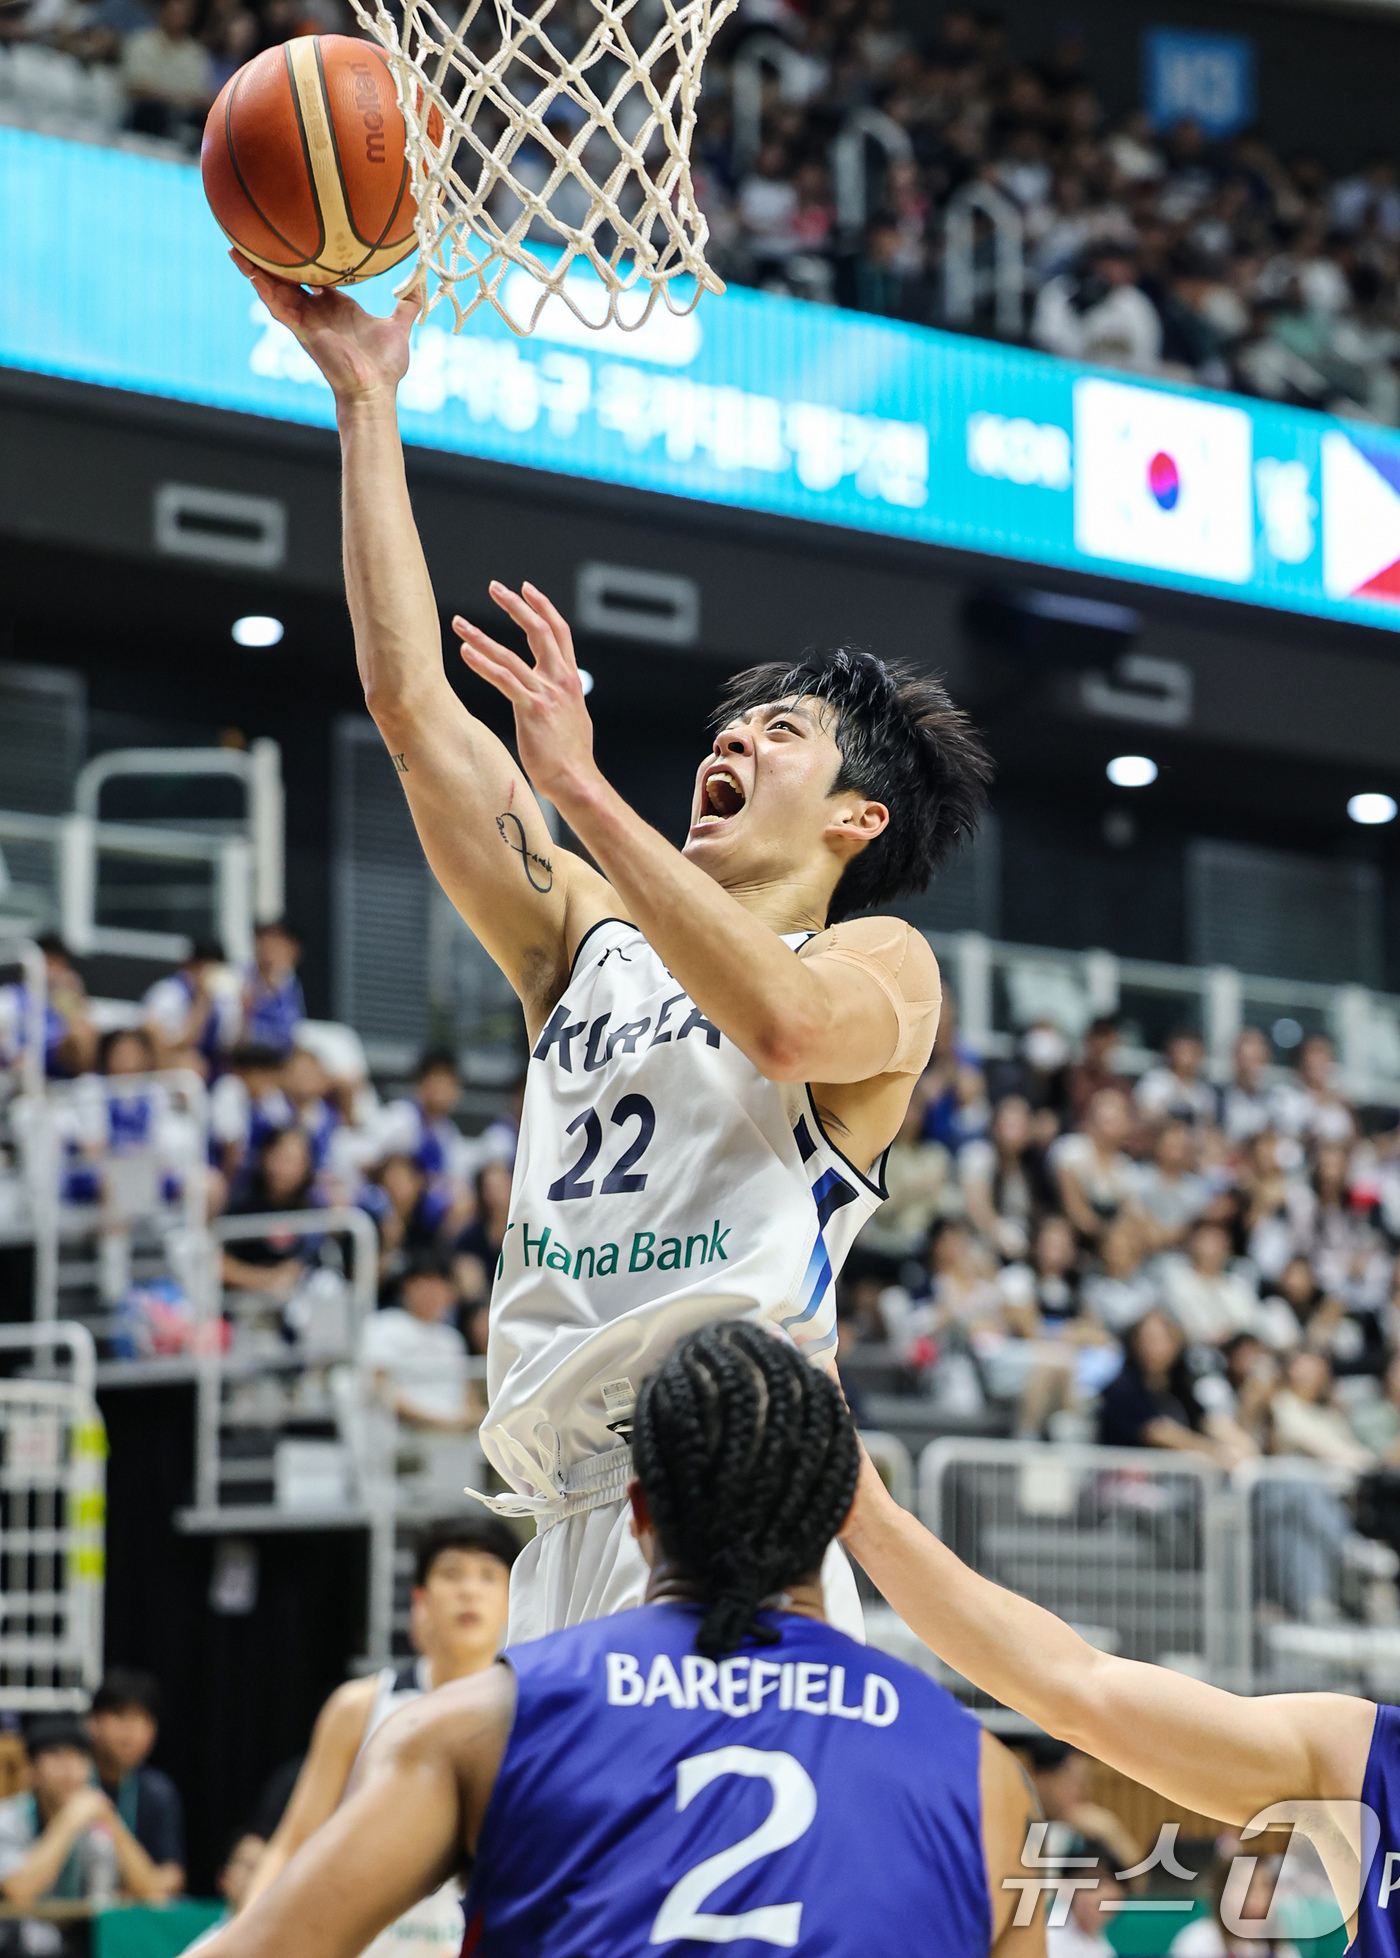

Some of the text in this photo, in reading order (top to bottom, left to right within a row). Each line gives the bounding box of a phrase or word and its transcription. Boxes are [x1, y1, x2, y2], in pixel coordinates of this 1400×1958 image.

[346, 61, 386, 164] molten
[532, 993, 721, 1074] KOREA
[547, 1093, 656, 1201] 22
[522, 1220, 732, 1279] Hana Bank
[606, 1651, 900, 1728] BAREFIELD
[650, 1744, 818, 1948] 2
